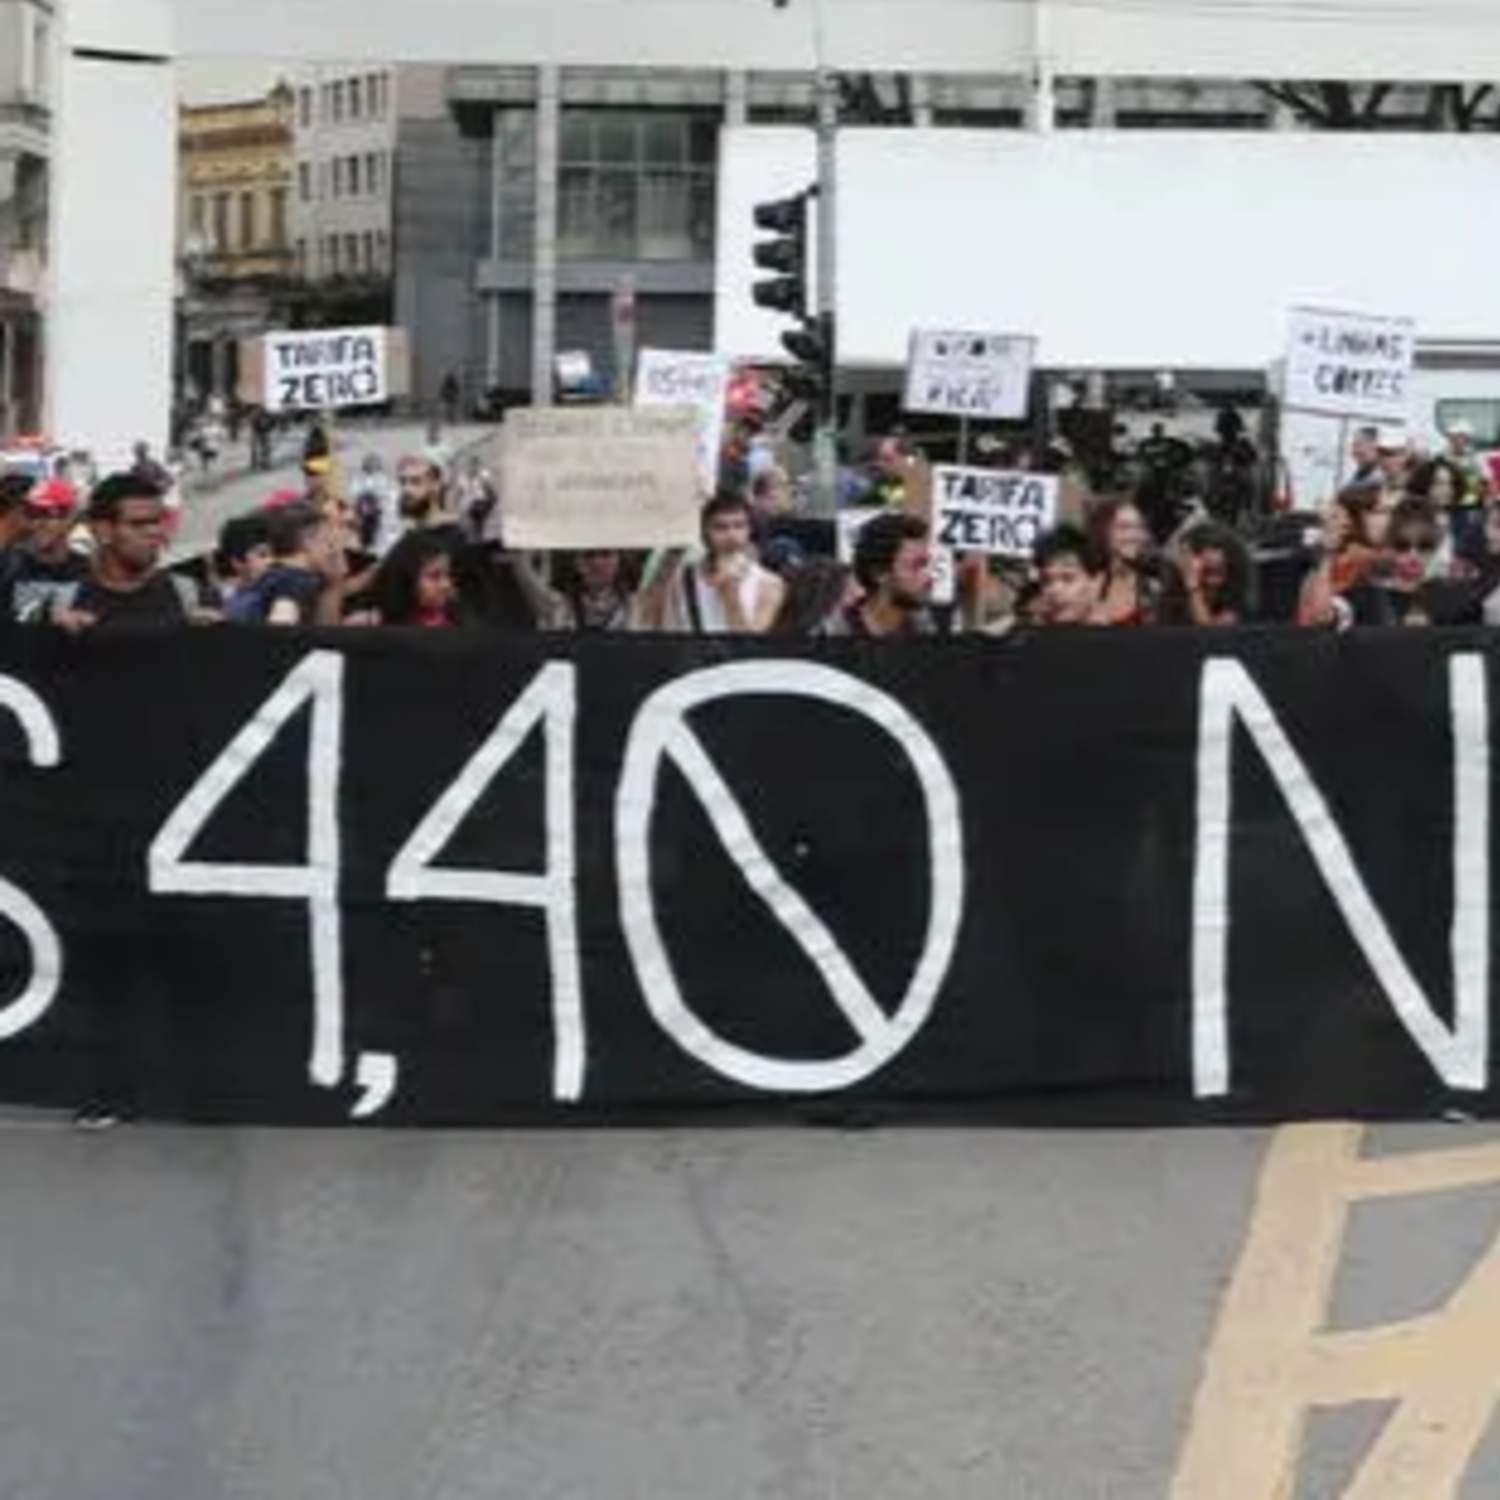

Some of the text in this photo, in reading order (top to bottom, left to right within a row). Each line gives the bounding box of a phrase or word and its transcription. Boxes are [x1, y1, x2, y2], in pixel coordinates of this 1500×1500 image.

[275, 335, 376, 368] TARIFA
[943, 472, 1045, 510] TARIFA
[938, 509, 1041, 549] ZERO
[148, 650, 964, 1117] 4,40
